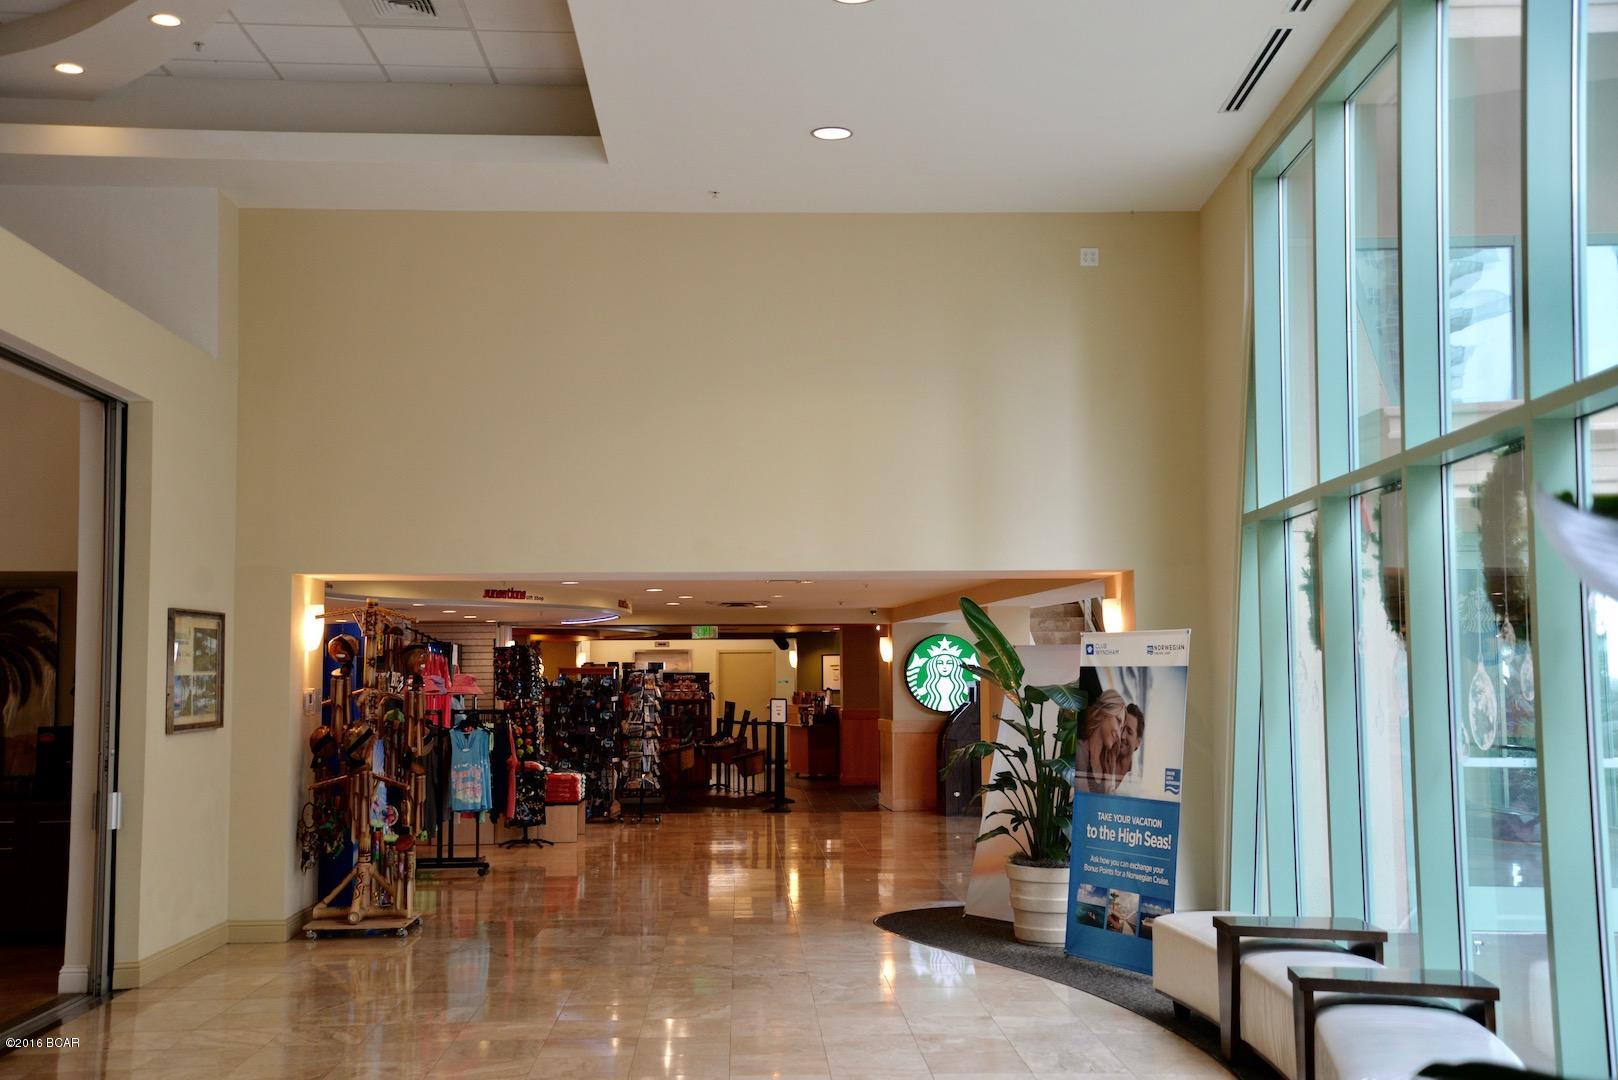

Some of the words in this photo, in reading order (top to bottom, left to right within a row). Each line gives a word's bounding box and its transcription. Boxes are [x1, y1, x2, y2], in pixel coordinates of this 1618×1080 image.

[1097, 812, 1112, 822] TAKE
[1113, 814, 1131, 824] YOUR
[1131, 816, 1163, 828] VACATION
[1086, 824, 1098, 838] to
[1099, 825, 1116, 841] the
[1118, 828, 1143, 847] High
[1144, 831, 1172, 850] Seas!
[1083, 863, 1099, 873] Bonus
[1099, 866, 1115, 876] Points
[1126, 871, 1153, 883] Norwegian
[1090, 855, 1100, 863] Ask
[1100, 856, 1110, 865] how
[1129, 862, 1153, 873] exchange
